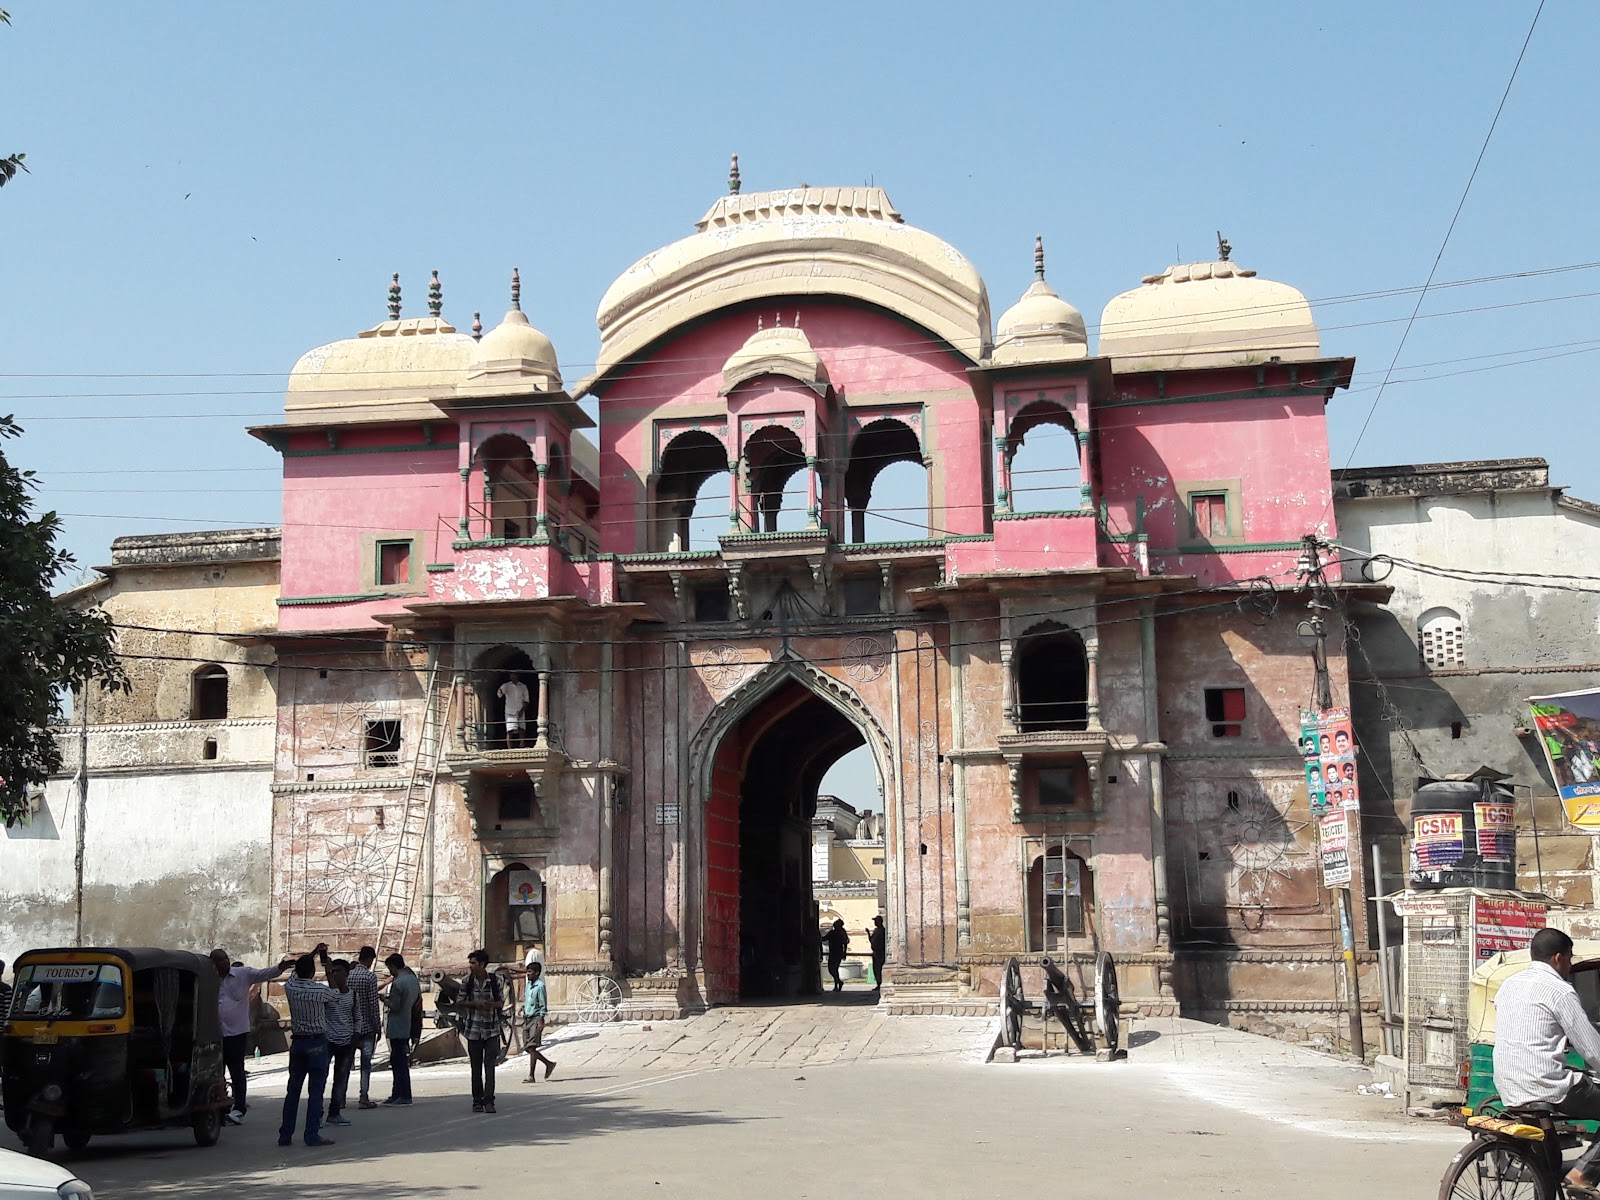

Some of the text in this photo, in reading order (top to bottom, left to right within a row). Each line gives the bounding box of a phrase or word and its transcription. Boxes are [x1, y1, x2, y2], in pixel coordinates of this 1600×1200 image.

[1482, 807, 1514, 823] ICSM
[1417, 818, 1456, 836] ICSM
[46, 968, 87, 978] TOURIST
